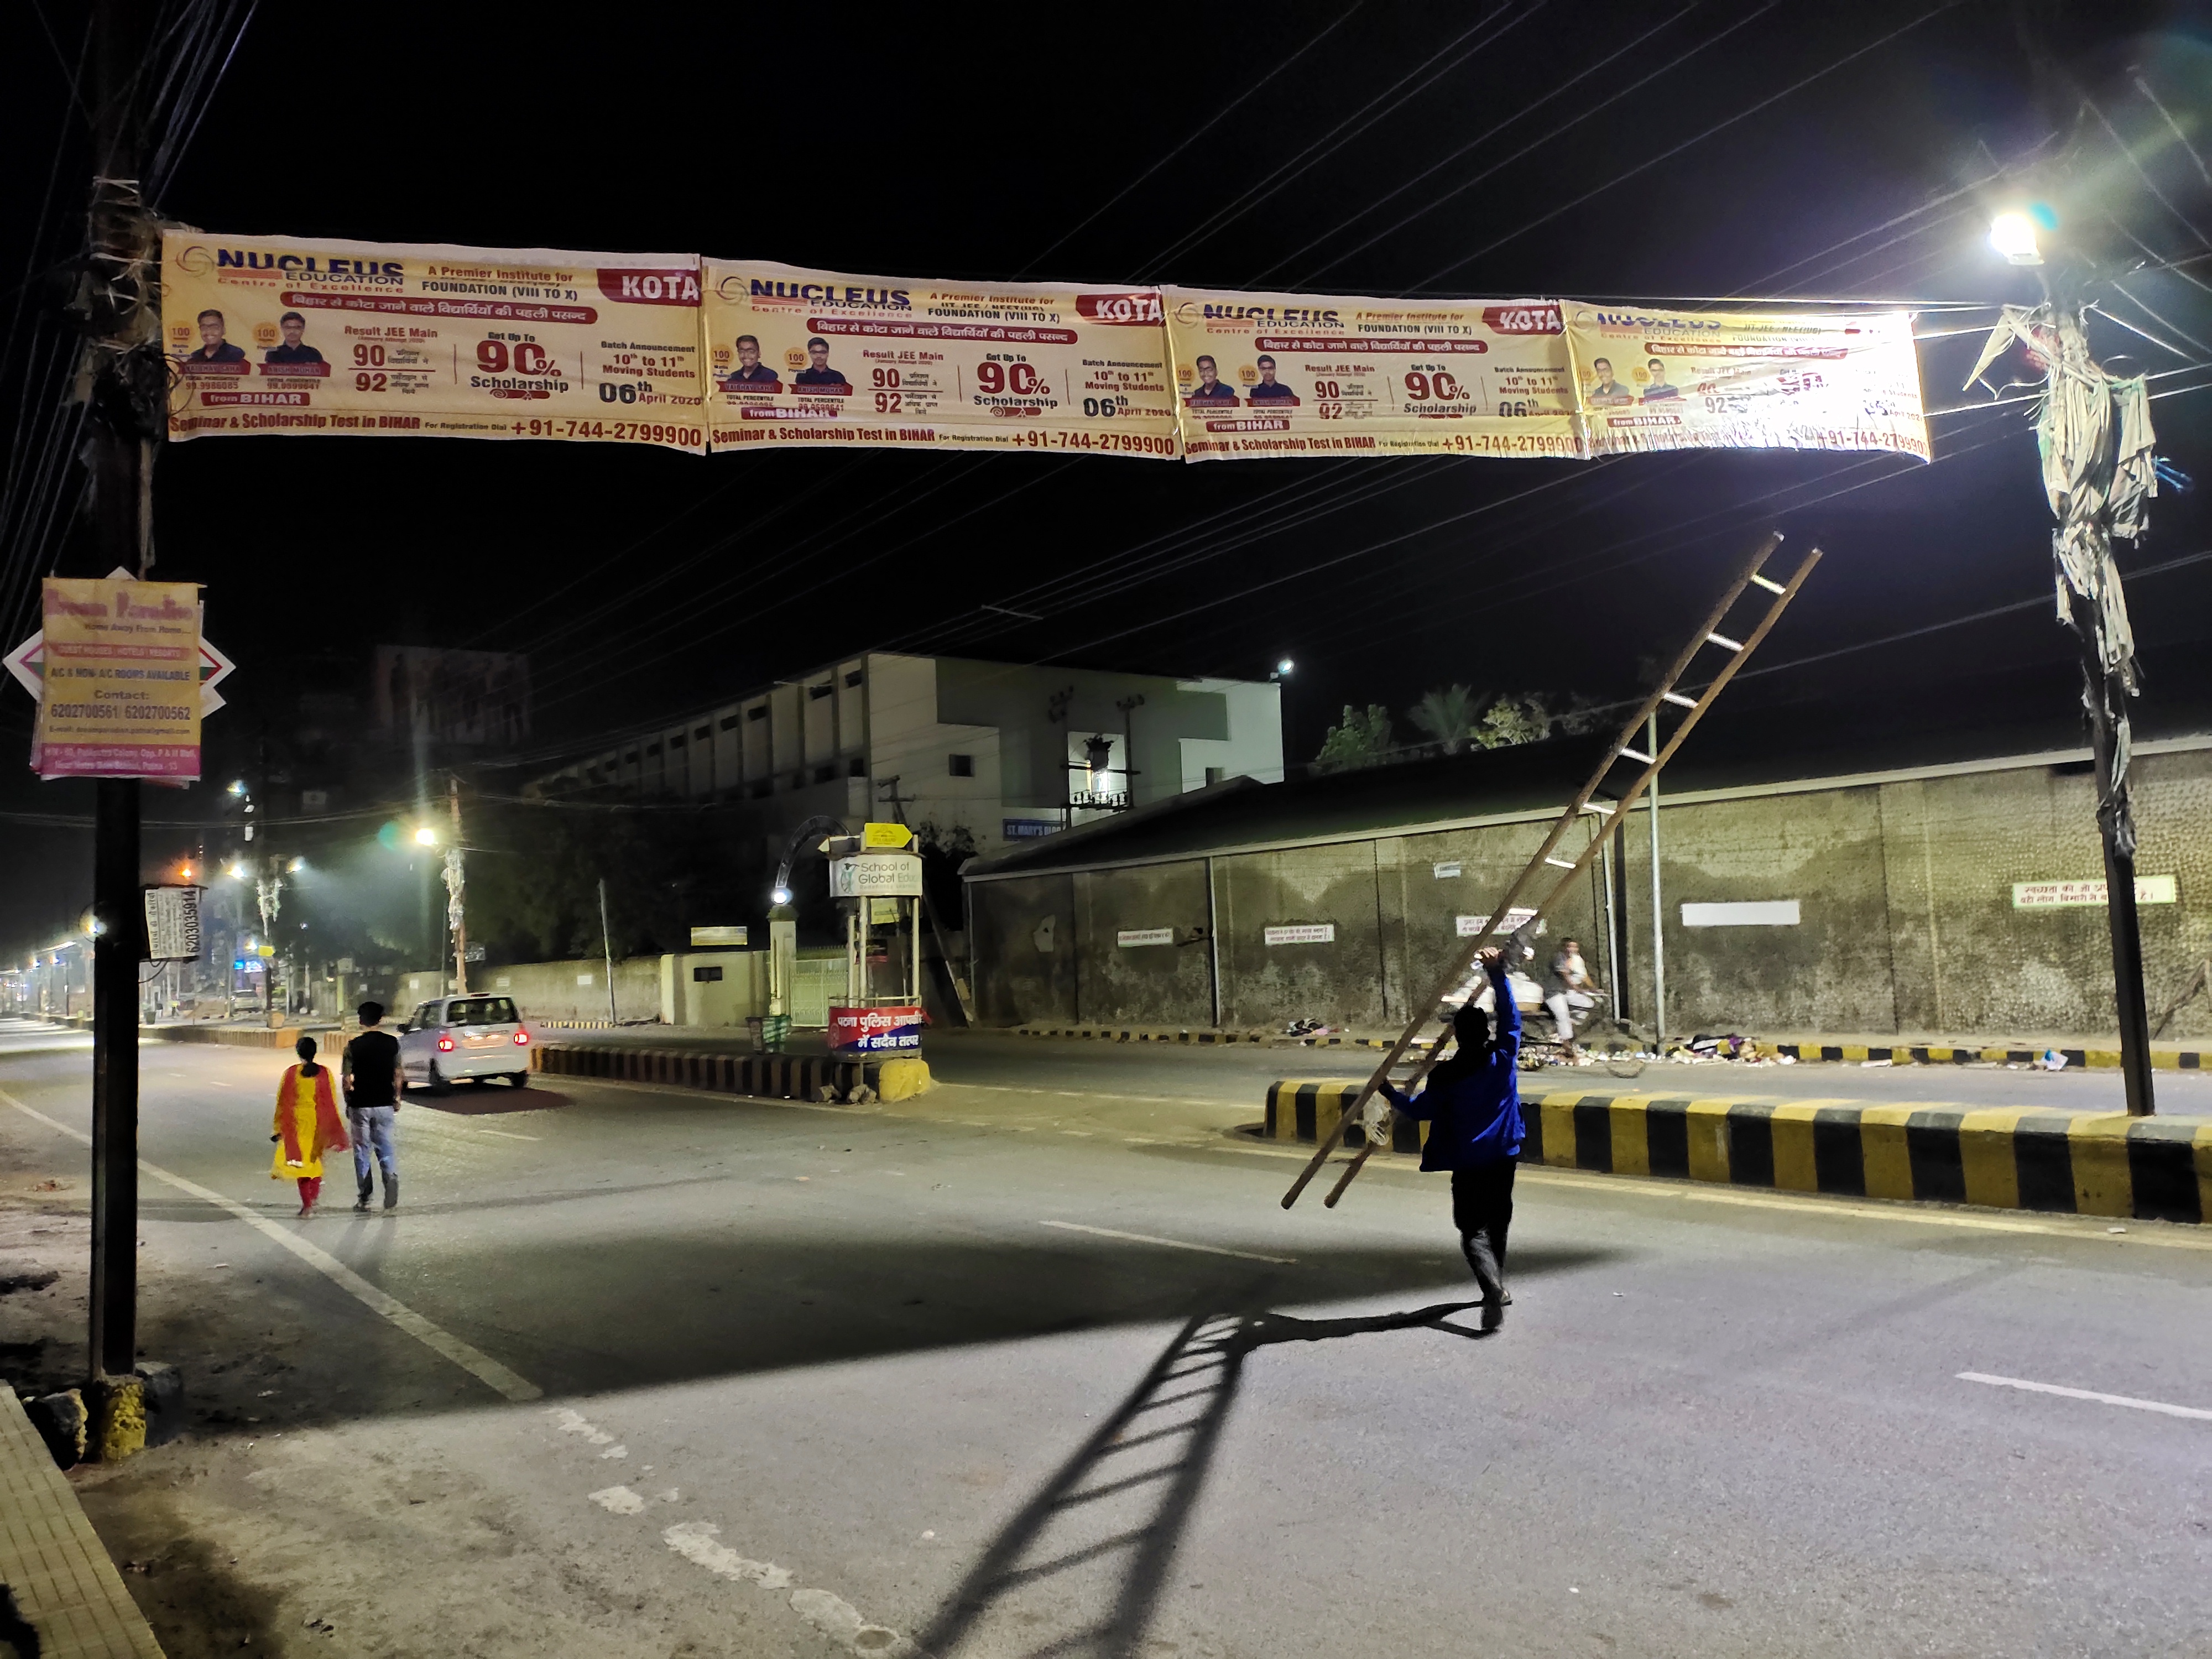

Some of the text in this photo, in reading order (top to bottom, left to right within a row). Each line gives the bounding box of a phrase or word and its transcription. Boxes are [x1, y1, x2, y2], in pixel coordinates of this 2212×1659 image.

[217, 248, 404, 276] NUCLEUS
[286, 272, 403, 286] EDUCATION
[429, 266, 573, 283] A Premier Institute for
[218, 278, 276, 288] Centre
[310, 283, 404, 294] Excellence
[422, 281, 578, 302] FOUNDATION (VIII TO X)
[622, 275, 699, 300] KOTA
[751, 279, 910, 306] NUCLEUS
[293, 294, 327, 306] बिहार
[330, 296, 342, 307] से
[346, 297, 375, 310] कोटा
[379, 299, 406, 311] जाने
[410, 301, 435, 314] वाले
[495, 304, 512, 317] की
[517, 306, 548, 319] पहली
[553, 310, 586, 321] पसन्द
[811, 300, 912, 311] EDUCATION
[1096, 299, 1162, 322] KOTA
[1203, 304, 1338, 322] NUCLEUS
[928, 308, 1000, 320] FOUNDATION
[1500, 310, 1561, 331] KOTA
[173, 327, 190, 336] 100
[257, 329, 275, 337] 100
[345, 326, 437, 338] Result JEE Main
[817, 320, 847, 332] बिहार
[850, 322, 860, 333] से
[863, 323, 888, 334] कोटा
[891, 325, 914, 335] जाने
[917, 326, 939, 336] वाले
[990, 327, 1005, 338] की
[1009, 329, 1036, 341] पहली
[1358, 324, 1420, 333] FOUNDATION
[1645, 328, 1720, 337] EDUCATION
[488, 332, 535, 343] Get Up To
[601, 341, 695, 353] Batch Announcement
[713, 350, 730, 359] 100
[863, 349, 943, 361] Result JEE Main
[353, 344, 384, 367] 90
[477, 340, 561, 378] 90%
[614, 354, 638, 366] 10th
[642, 356, 655, 366] to
[789, 353, 804, 362] 100
[602, 364, 695, 379] Moving Students
[873, 368, 900, 388] 90
[977, 362, 1050, 394] 90%
[356, 373, 387, 392] 92
[471, 376, 568, 393] Scholarship
[1315, 381, 1339, 399] 90
[1405, 372, 1470, 400] 90%
[211, 394, 301, 404] from BIHAR
[639, 394, 701, 406] April 2020
[875, 393, 901, 413] 92
[973, 395, 1058, 409] Scholarship
[1705, 397, 1728, 414] 92
[749, 409, 775, 418] from
[776, 408, 830, 418] BIHAR
[1118, 408, 1141, 417] April
[1319, 403, 1343, 420] 92
[1404, 403, 1477, 414] Scholarship
[171, 416, 227, 432] Seminar
[229, 416, 239, 429] &
[242, 413, 326, 429] Scholarship
[330, 415, 358, 428] Test
[362, 415, 375, 428] in
[379, 415, 420, 429] BIHAR
[440, 422, 489, 431] Registration
[512, 419, 701, 446] +91-744-2799900
[1237, 420, 1284, 431] BIHAR
[1614, 417, 1676, 427] from BIHAR
[713, 426, 1175, 455] Seminar & Scholarship Test in BIHAR +91-744-2799900
[1185, 439, 1229, 454] Seminar
[1242, 438, 1306, 451] Scholarship
[1345, 437, 1375, 448] BIHAR
[115, 669, 144, 679] ROOMS
[146, 670, 190, 681] AVAILABLE
[94, 690, 150, 700] Contact:
[51, 704, 190, 721] 6202700561 6202700562
[1018, 825, 1043, 836] MARY'S
[862, 862, 909, 872] School of
[859, 873, 894, 884] Global
[182, 891, 200, 953] 6203035914
[837, 1016, 857, 1028] पटना
[860, 1012, 891, 1032] पुलिस
[858, 1032, 919, 1048] में सदैव तत्पर
